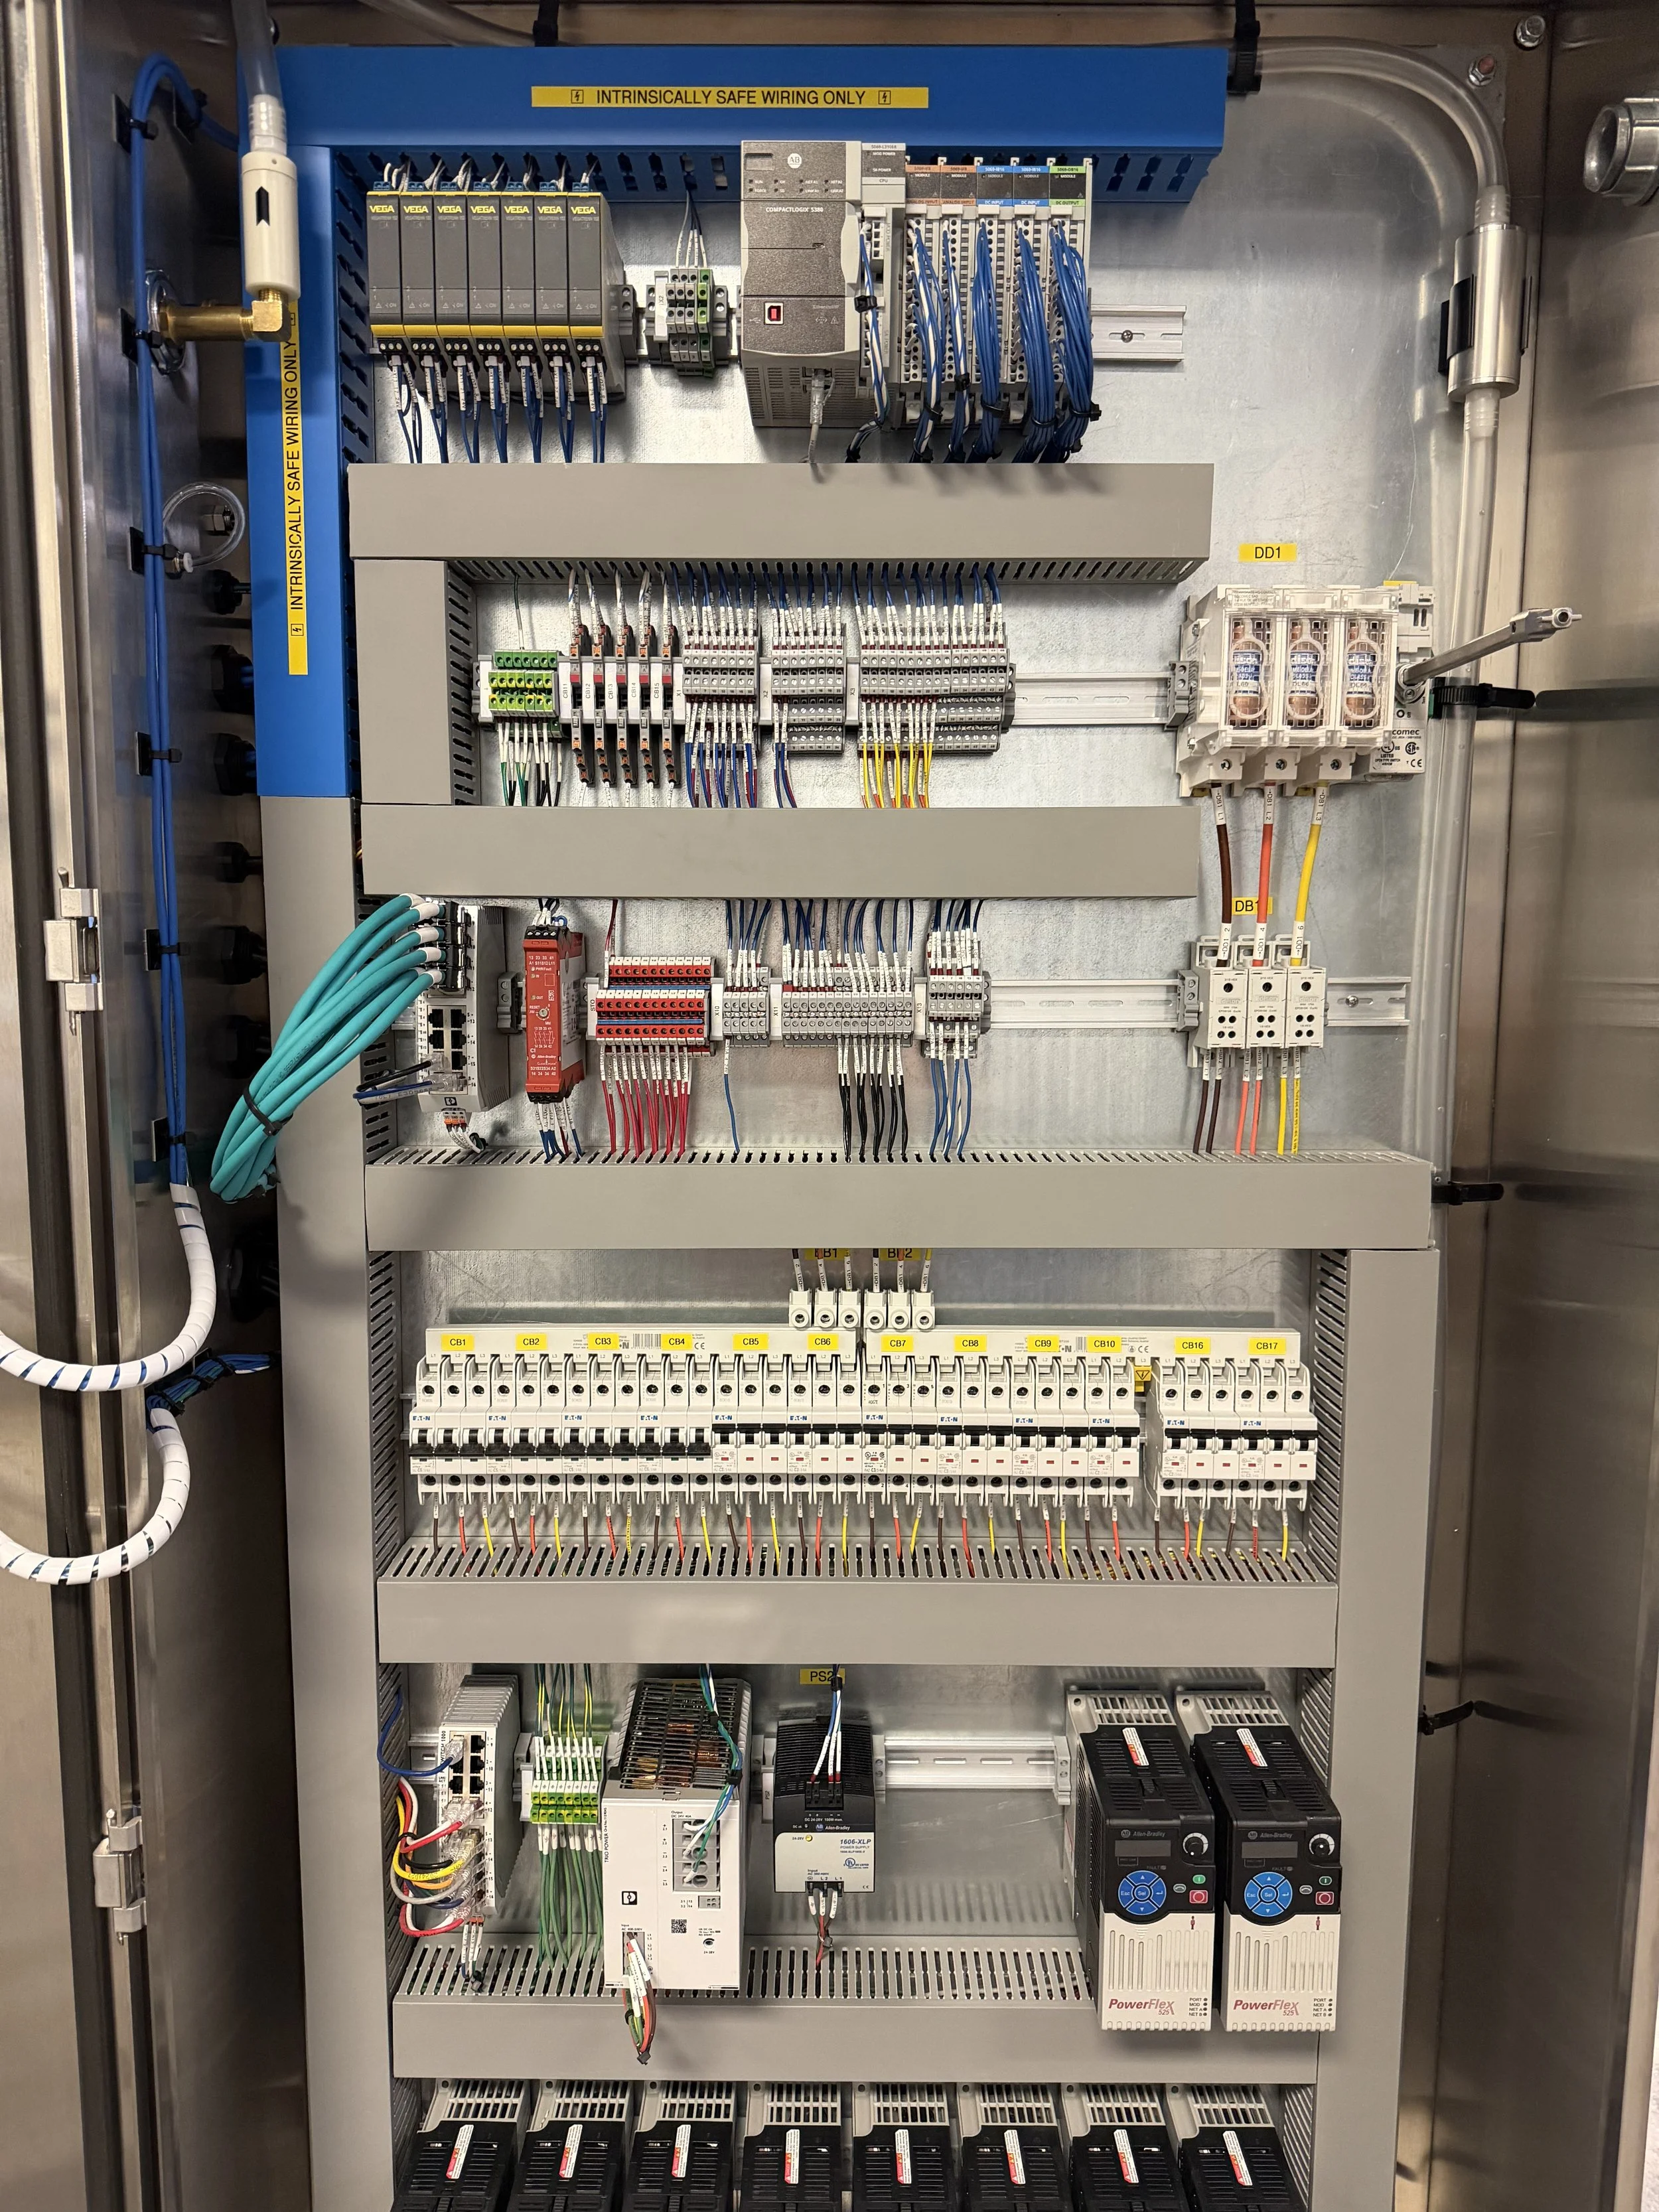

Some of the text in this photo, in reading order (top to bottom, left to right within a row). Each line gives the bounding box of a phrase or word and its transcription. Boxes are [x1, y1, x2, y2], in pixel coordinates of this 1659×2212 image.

[597, 90, 865, 105] INTRINSICALLY SAFE WIRING ONLY
[284, 341, 303, 609] INTRINSICALLY SAFE WIRING ONLY
[1255, 546, 1280, 558] DD1
[810, 1671, 834, 1682] PS2
[1108, 1998, 1175, 2014] PowerFlex
[1233, 1999, 1299, 2014] PowerFlex
